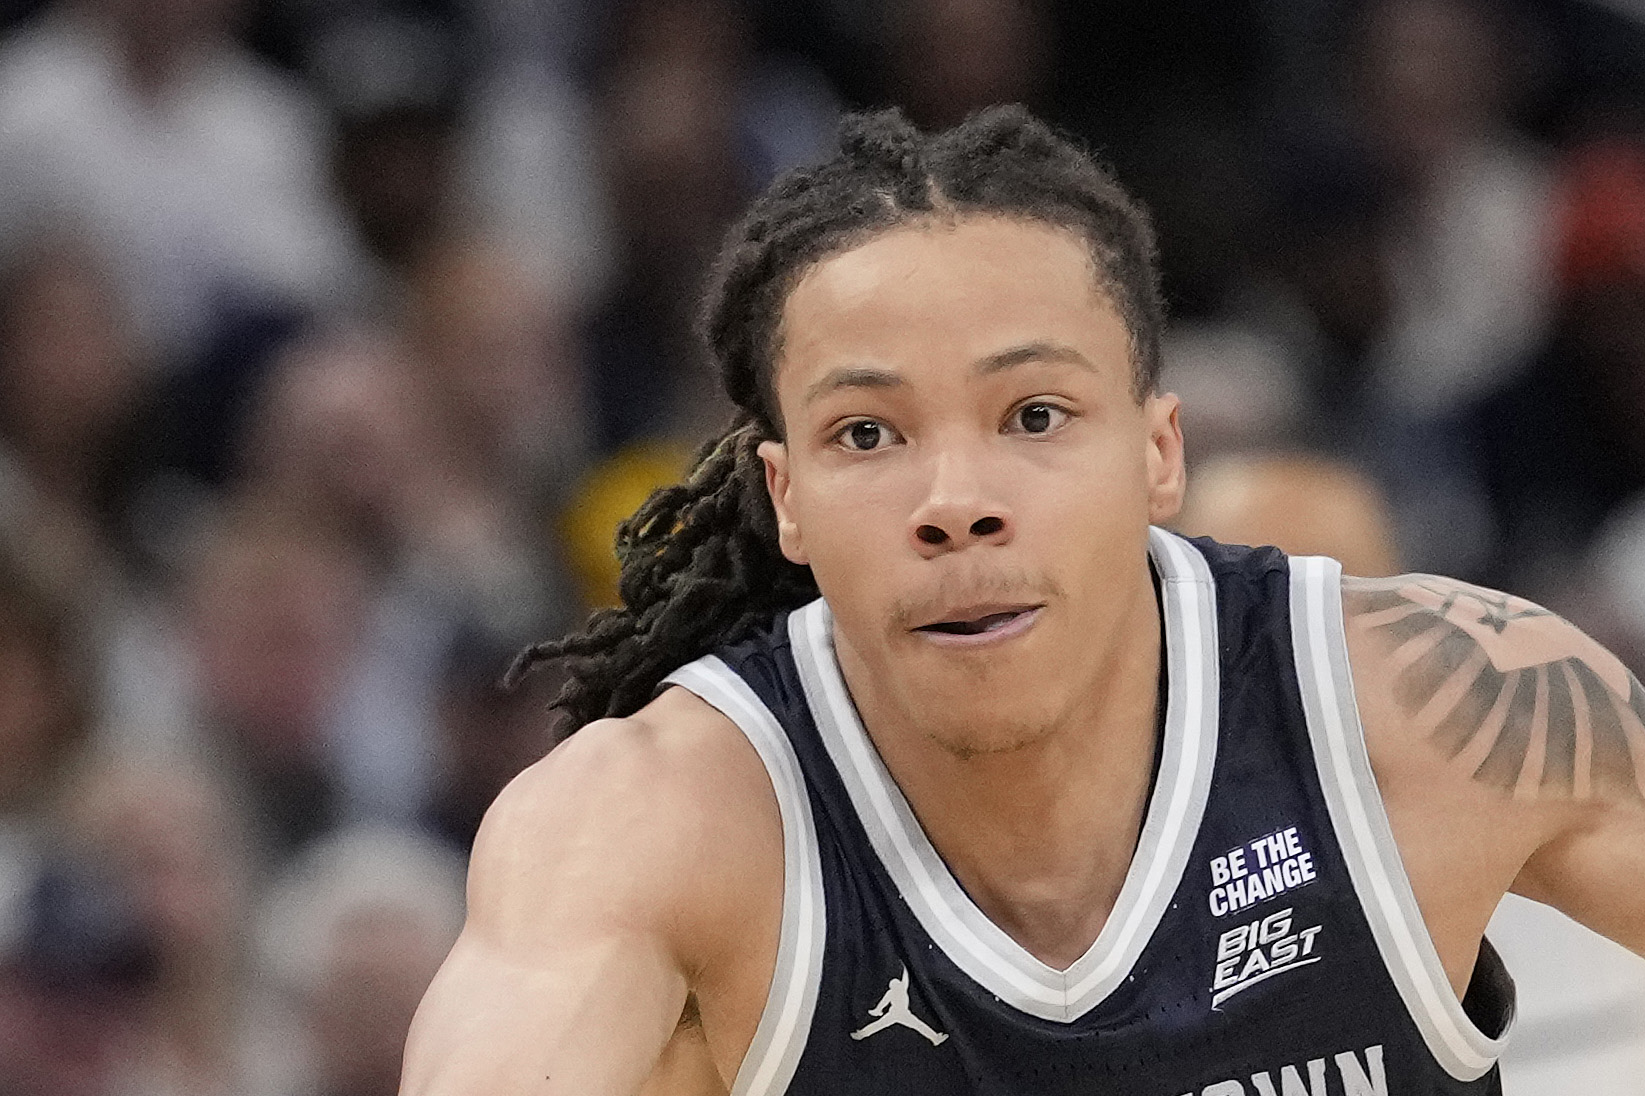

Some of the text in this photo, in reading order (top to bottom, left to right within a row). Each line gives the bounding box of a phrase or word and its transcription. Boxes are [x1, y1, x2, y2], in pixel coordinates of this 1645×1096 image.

[1208, 852, 1316, 917] CHANGE
[1210, 826, 1303, 887] BE THE
[1213, 925, 1322, 990] EAST
[1217, 907, 1294, 962] BIG
